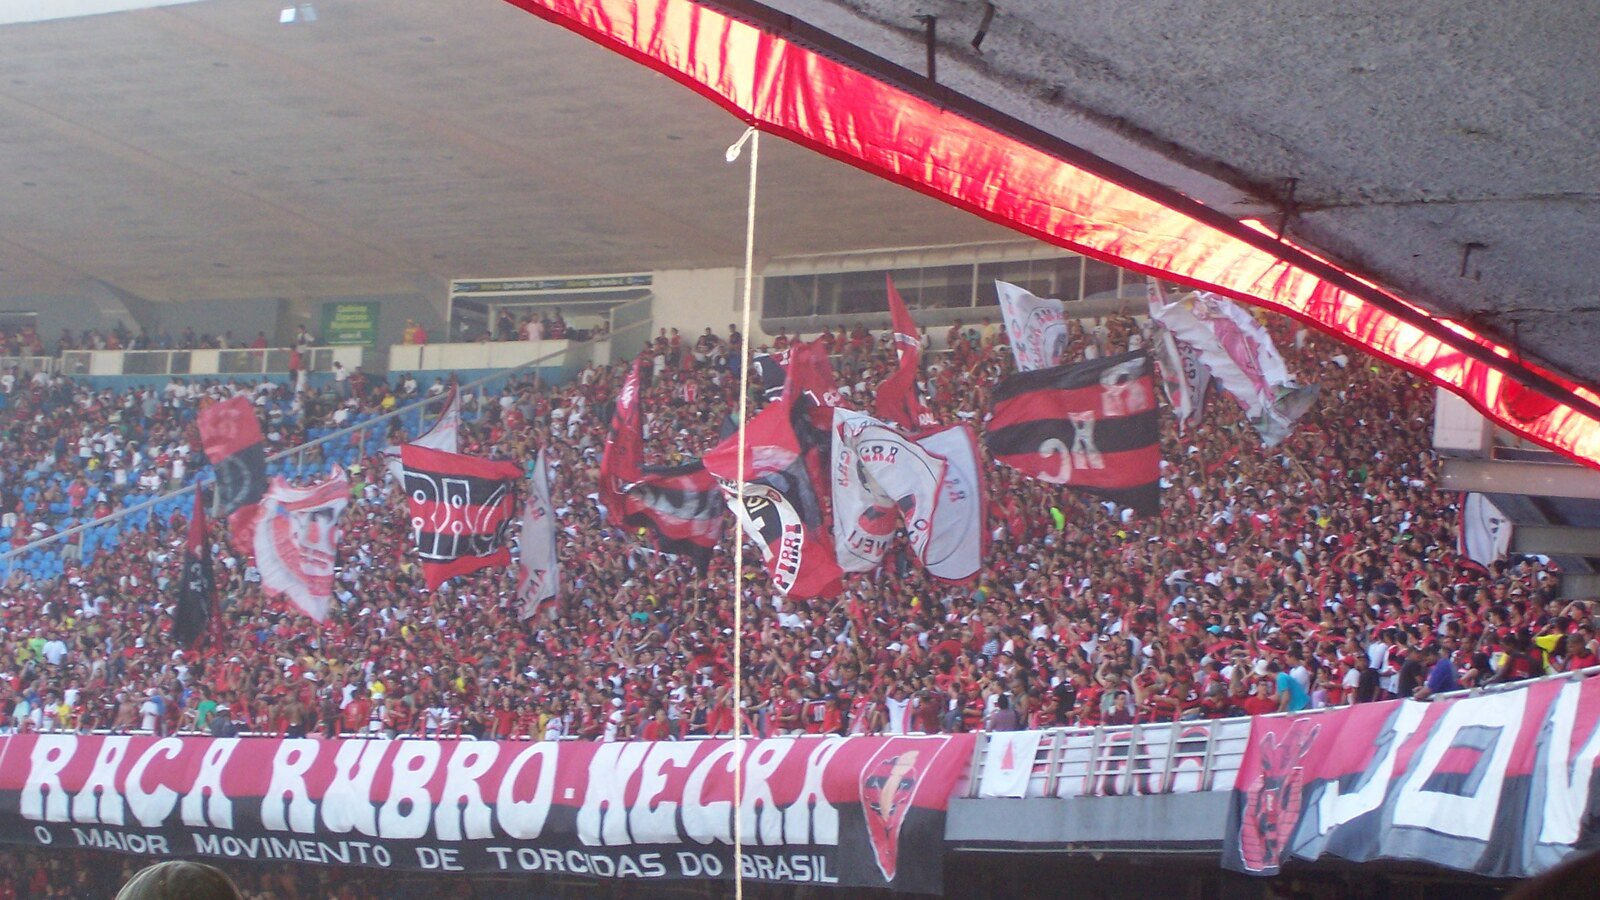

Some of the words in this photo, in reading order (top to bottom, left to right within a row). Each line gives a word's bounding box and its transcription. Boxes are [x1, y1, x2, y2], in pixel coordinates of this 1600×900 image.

[34, 825, 52, 845] O
[72, 827, 171, 855] MAIOR
[194, 833, 392, 868] MOVIMENTO
[415, 847, 466, 872] DE
[486, 846, 666, 879] TORCIDAS
[675, 850, 723, 878] DO
[740, 854, 839, 884] BRASIL
